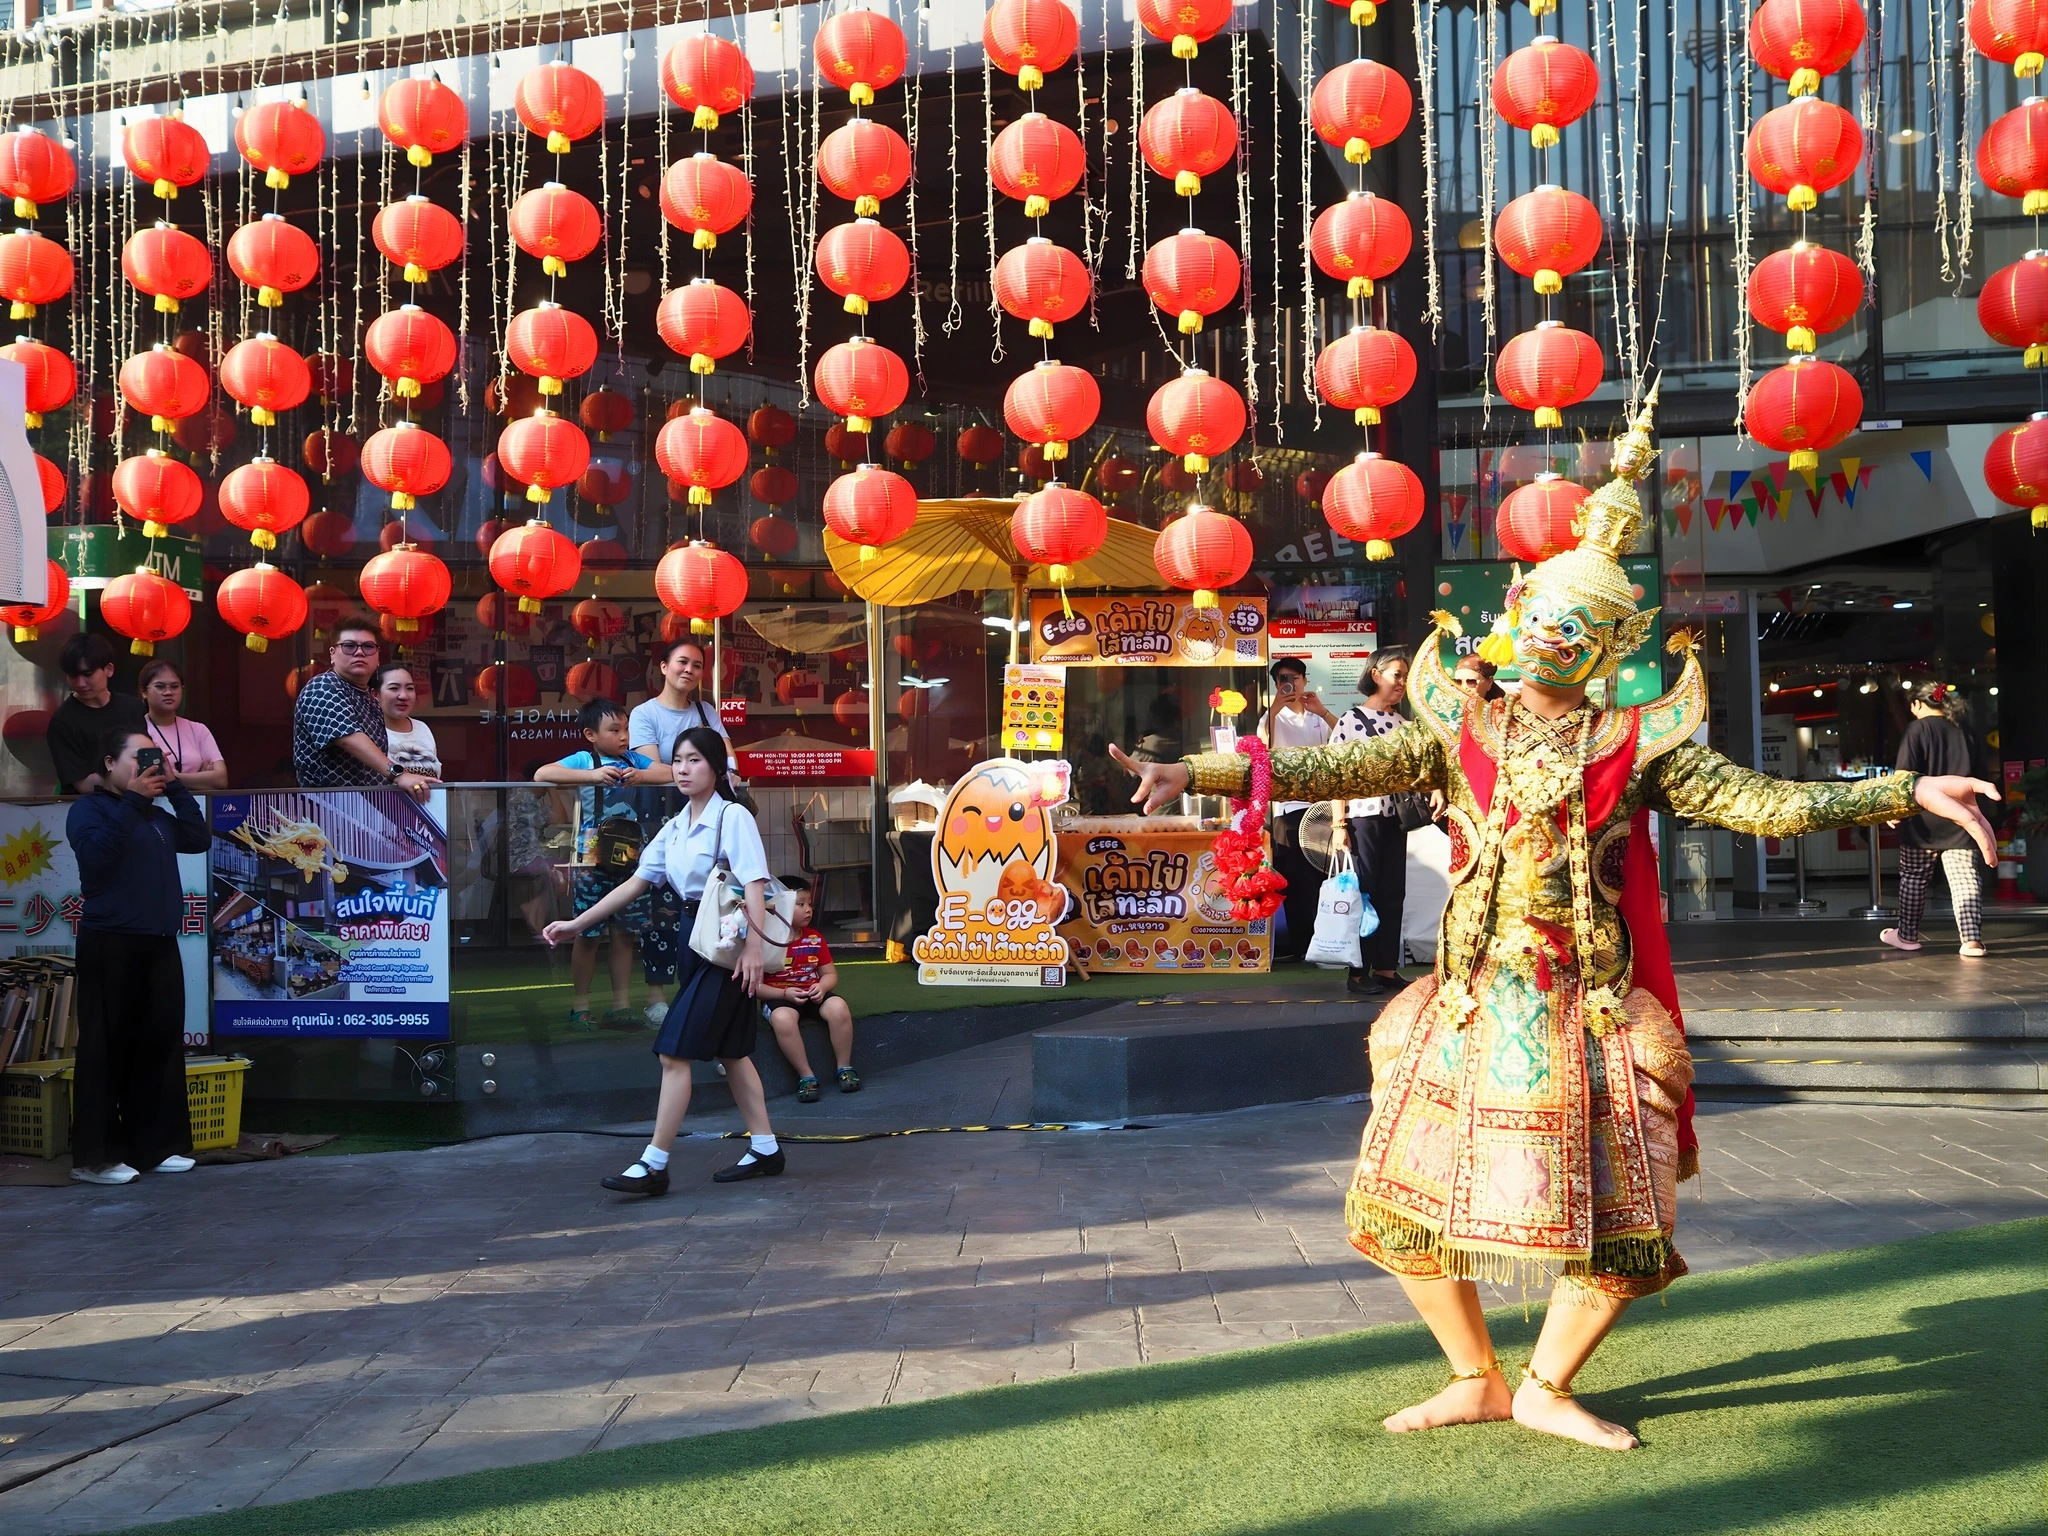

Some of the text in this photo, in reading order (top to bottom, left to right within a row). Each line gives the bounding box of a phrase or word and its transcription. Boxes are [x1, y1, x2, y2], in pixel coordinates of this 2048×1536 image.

[917, 280, 989, 302] Refill
[144, 550, 180, 582] ATM
[1236, 612, 1259, 627] 59
[1347, 622, 1372, 632] KFC
[1042, 618, 1086, 641] E-EGG
[734, 637, 766, 649] FRESH
[733, 652, 765, 664] FRESH
[721, 701, 745, 710] KFC
[1089, 840, 1118, 853] E-EGG
[336, 883, 436, 918] สนใจพื้นที่
[340, 920, 430, 941] ราคาพิเศษ!
[340, 964, 354, 972] Shop
[390, 964, 401, 973] Pop
[402, 964, 409, 973] Up
[292, 1013, 334, 1030] คุณหนิง
[343, 1014, 430, 1026] 062-305-9955
